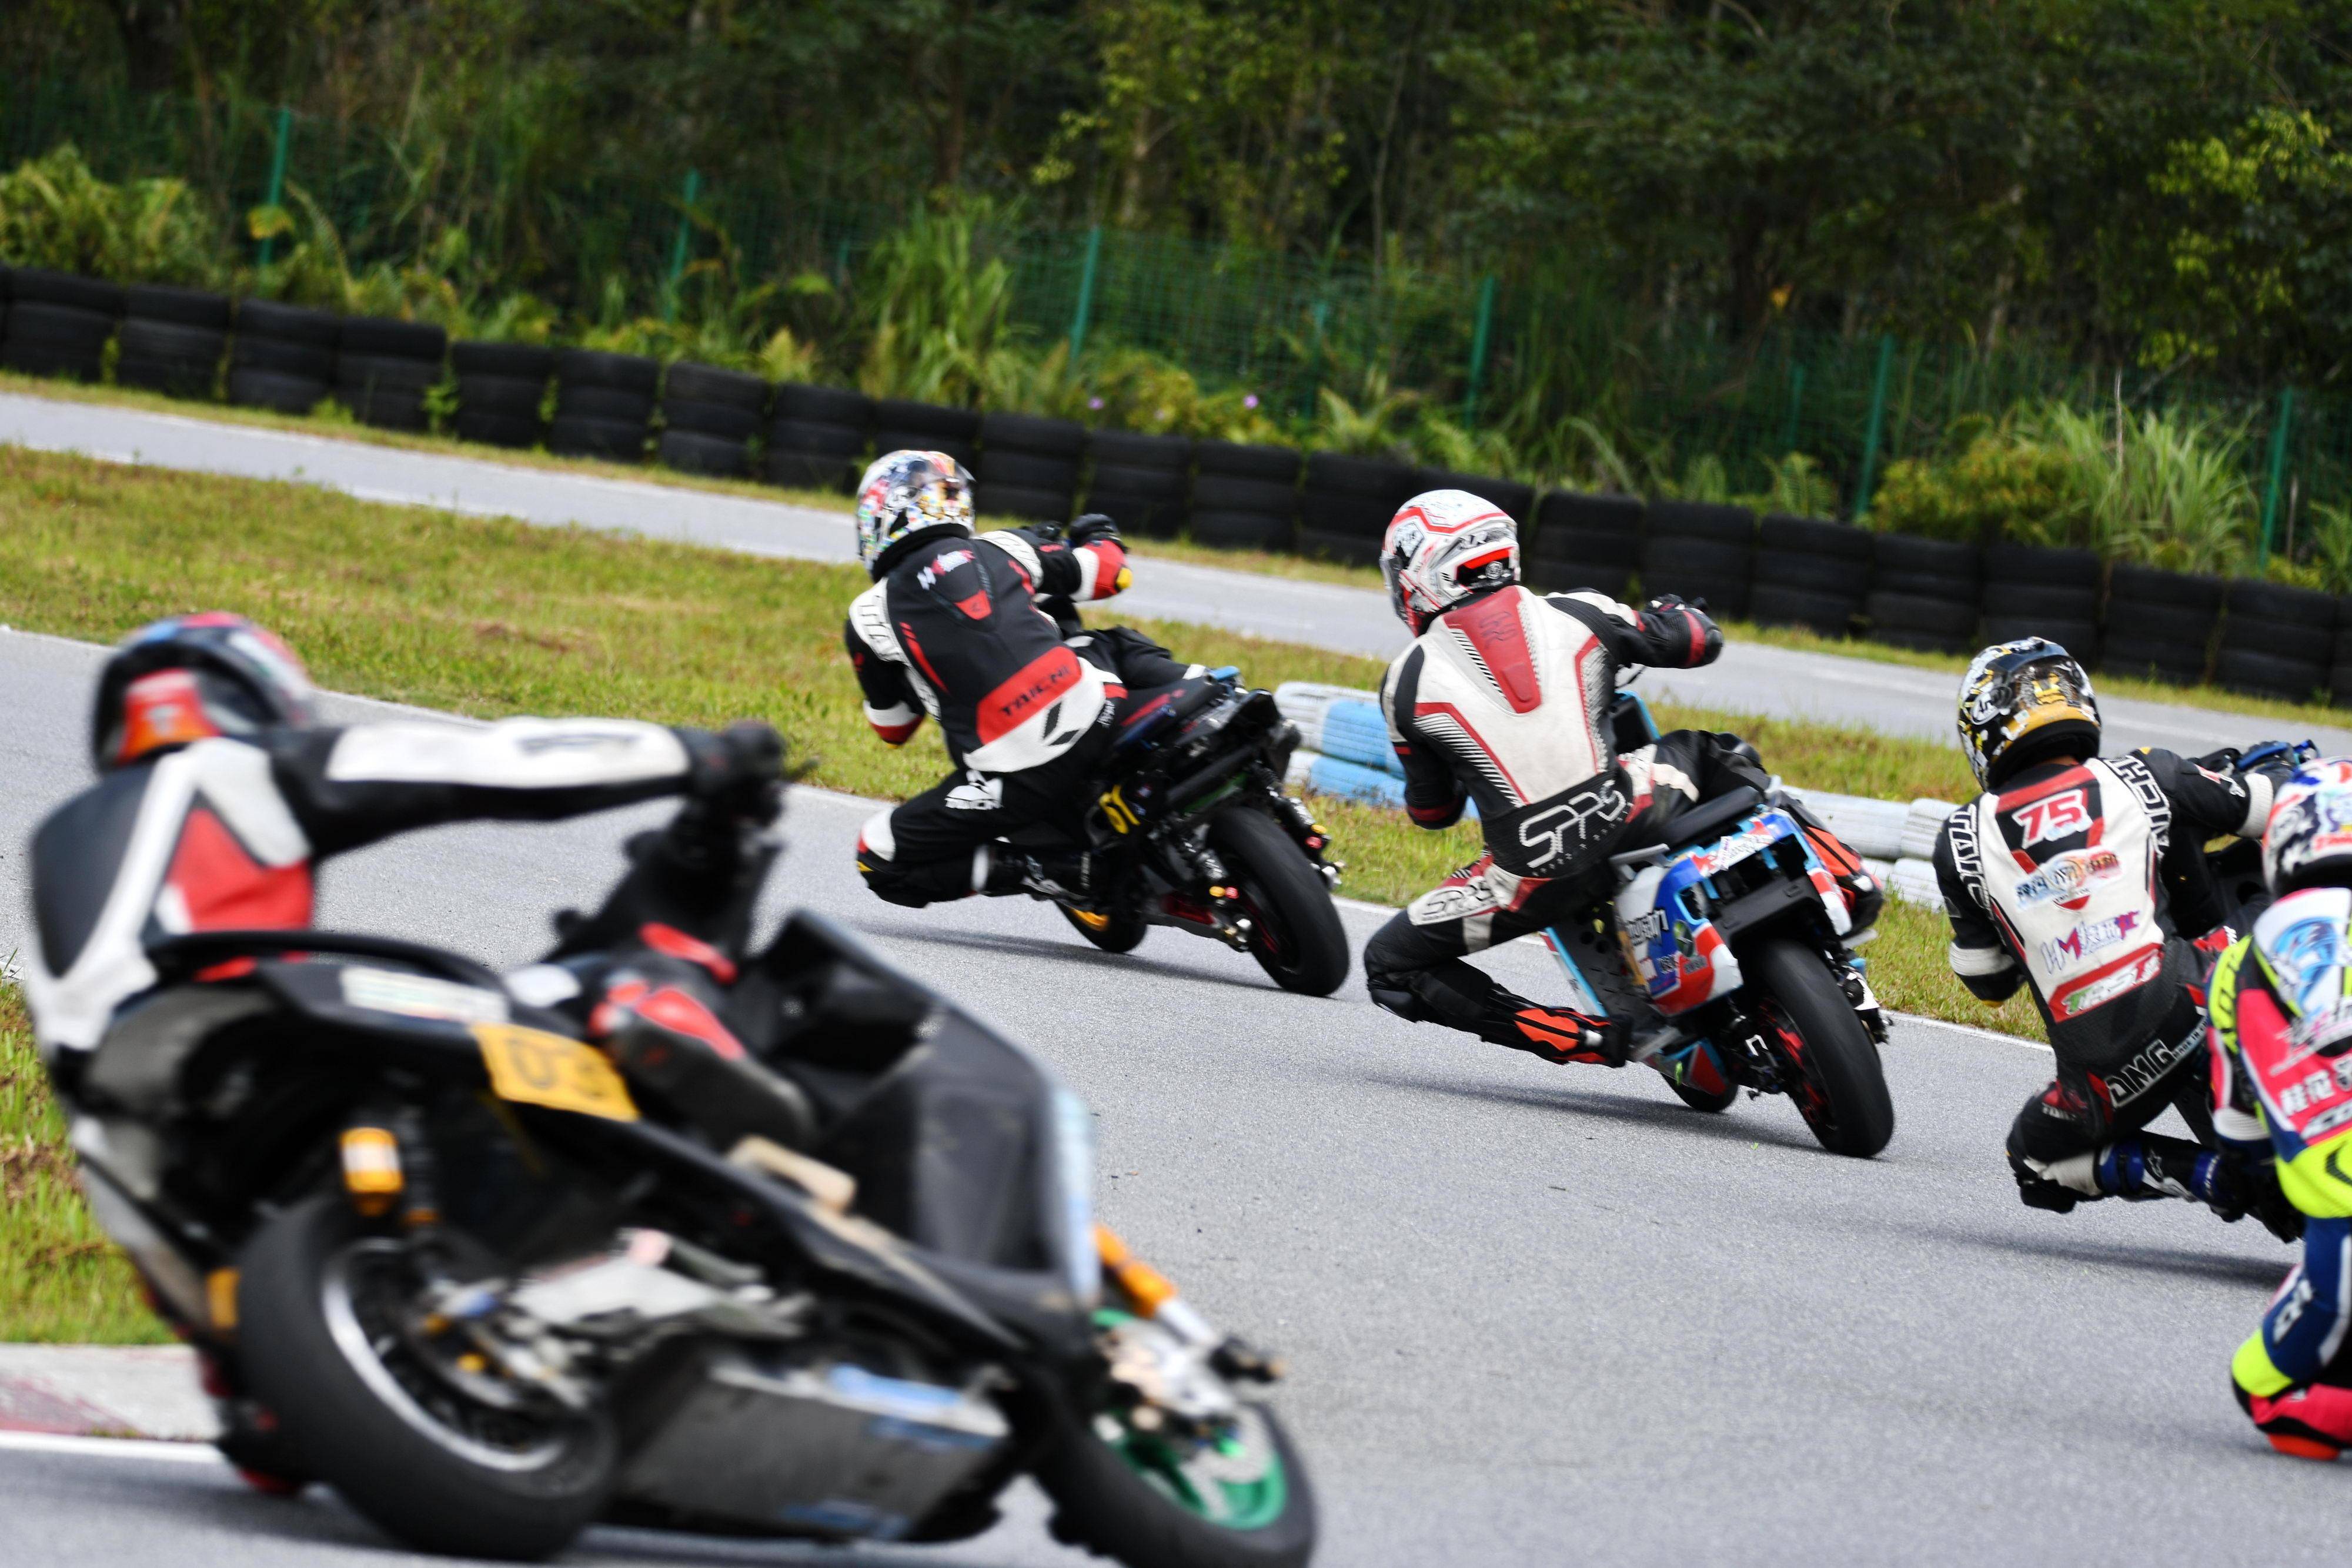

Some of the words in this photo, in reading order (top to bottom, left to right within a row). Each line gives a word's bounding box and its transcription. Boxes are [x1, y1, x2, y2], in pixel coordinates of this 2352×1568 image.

[2016, 794, 2085, 844] 75
[1948, 803, 1992, 913] TAIC
[2104, 1039, 2177, 1108] DMG
